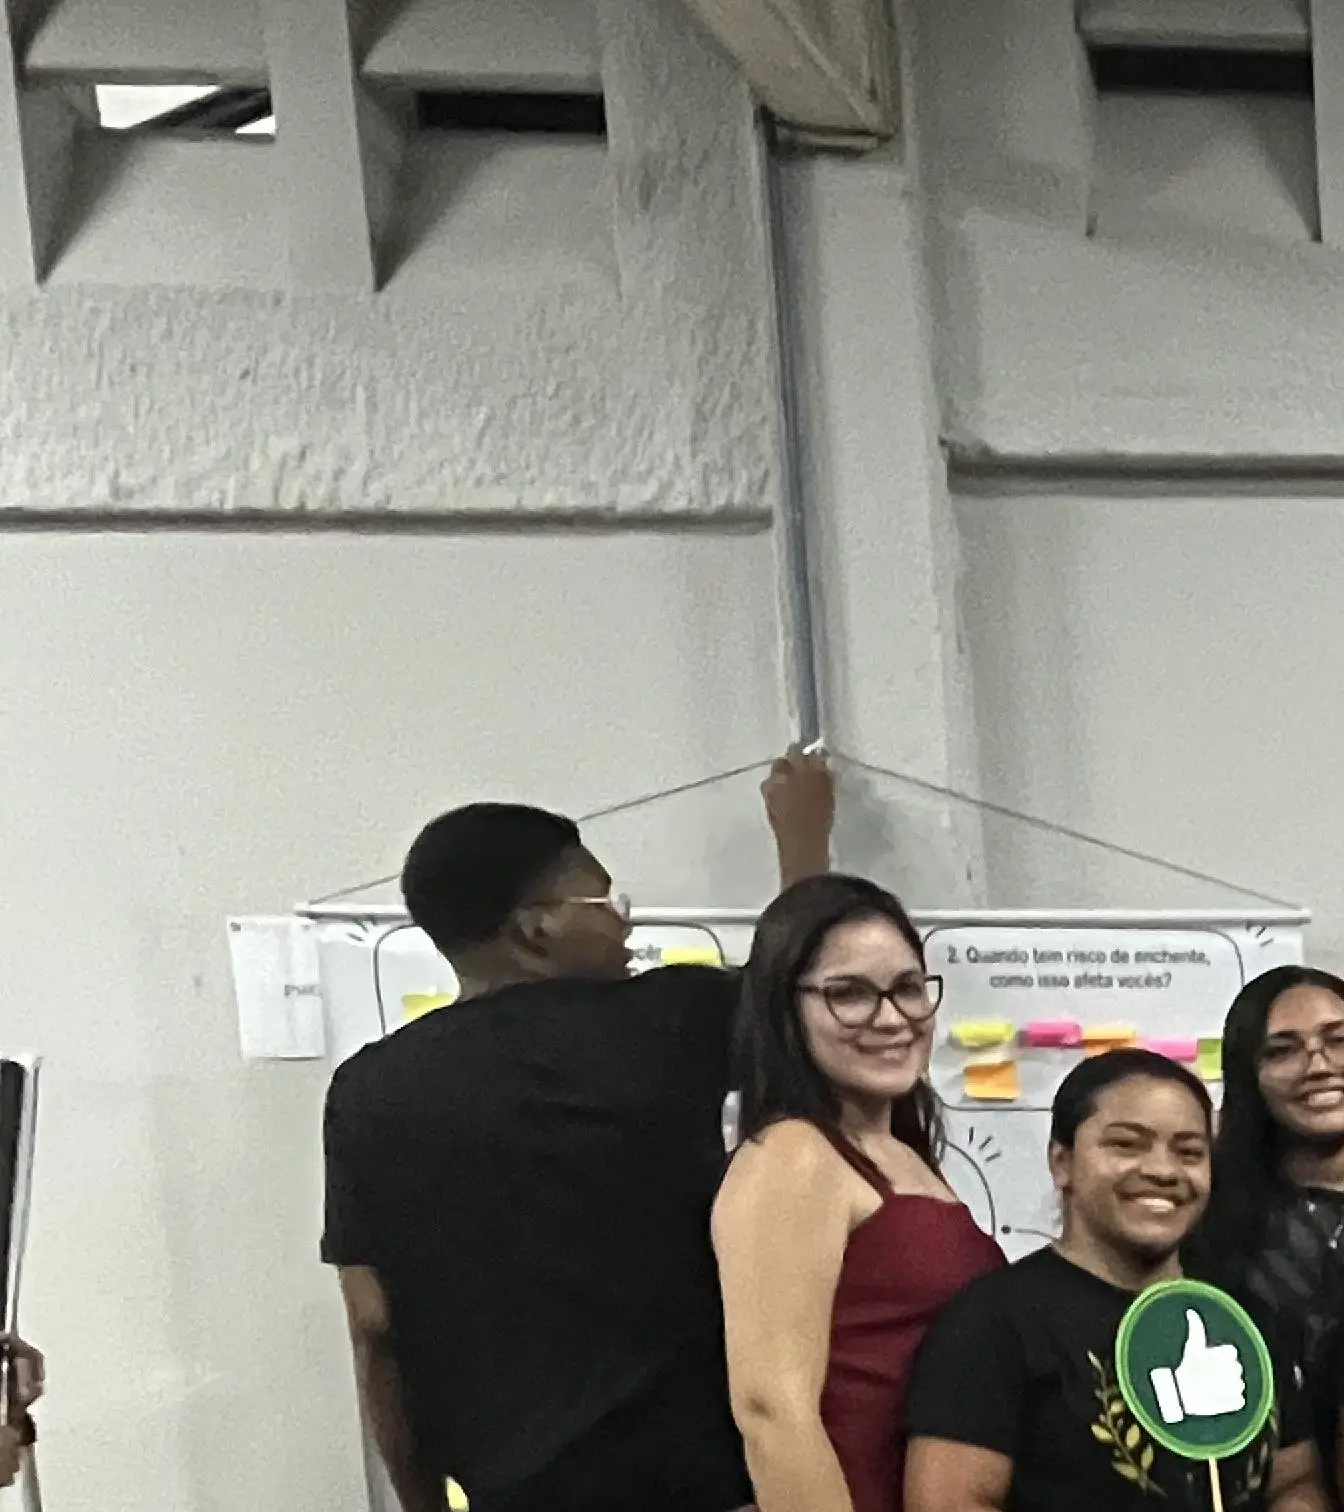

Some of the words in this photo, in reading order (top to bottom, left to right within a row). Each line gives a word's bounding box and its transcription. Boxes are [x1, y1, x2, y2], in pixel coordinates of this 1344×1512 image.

[966, 946, 1029, 964] Quando
[1033, 947, 1063, 964] tem
[1066, 948, 1106, 964] risco
[1110, 947, 1130, 964] de
[989, 974, 1034, 988] como
[1038, 973, 1070, 988] isso
[1074, 970, 1114, 988] afeta
